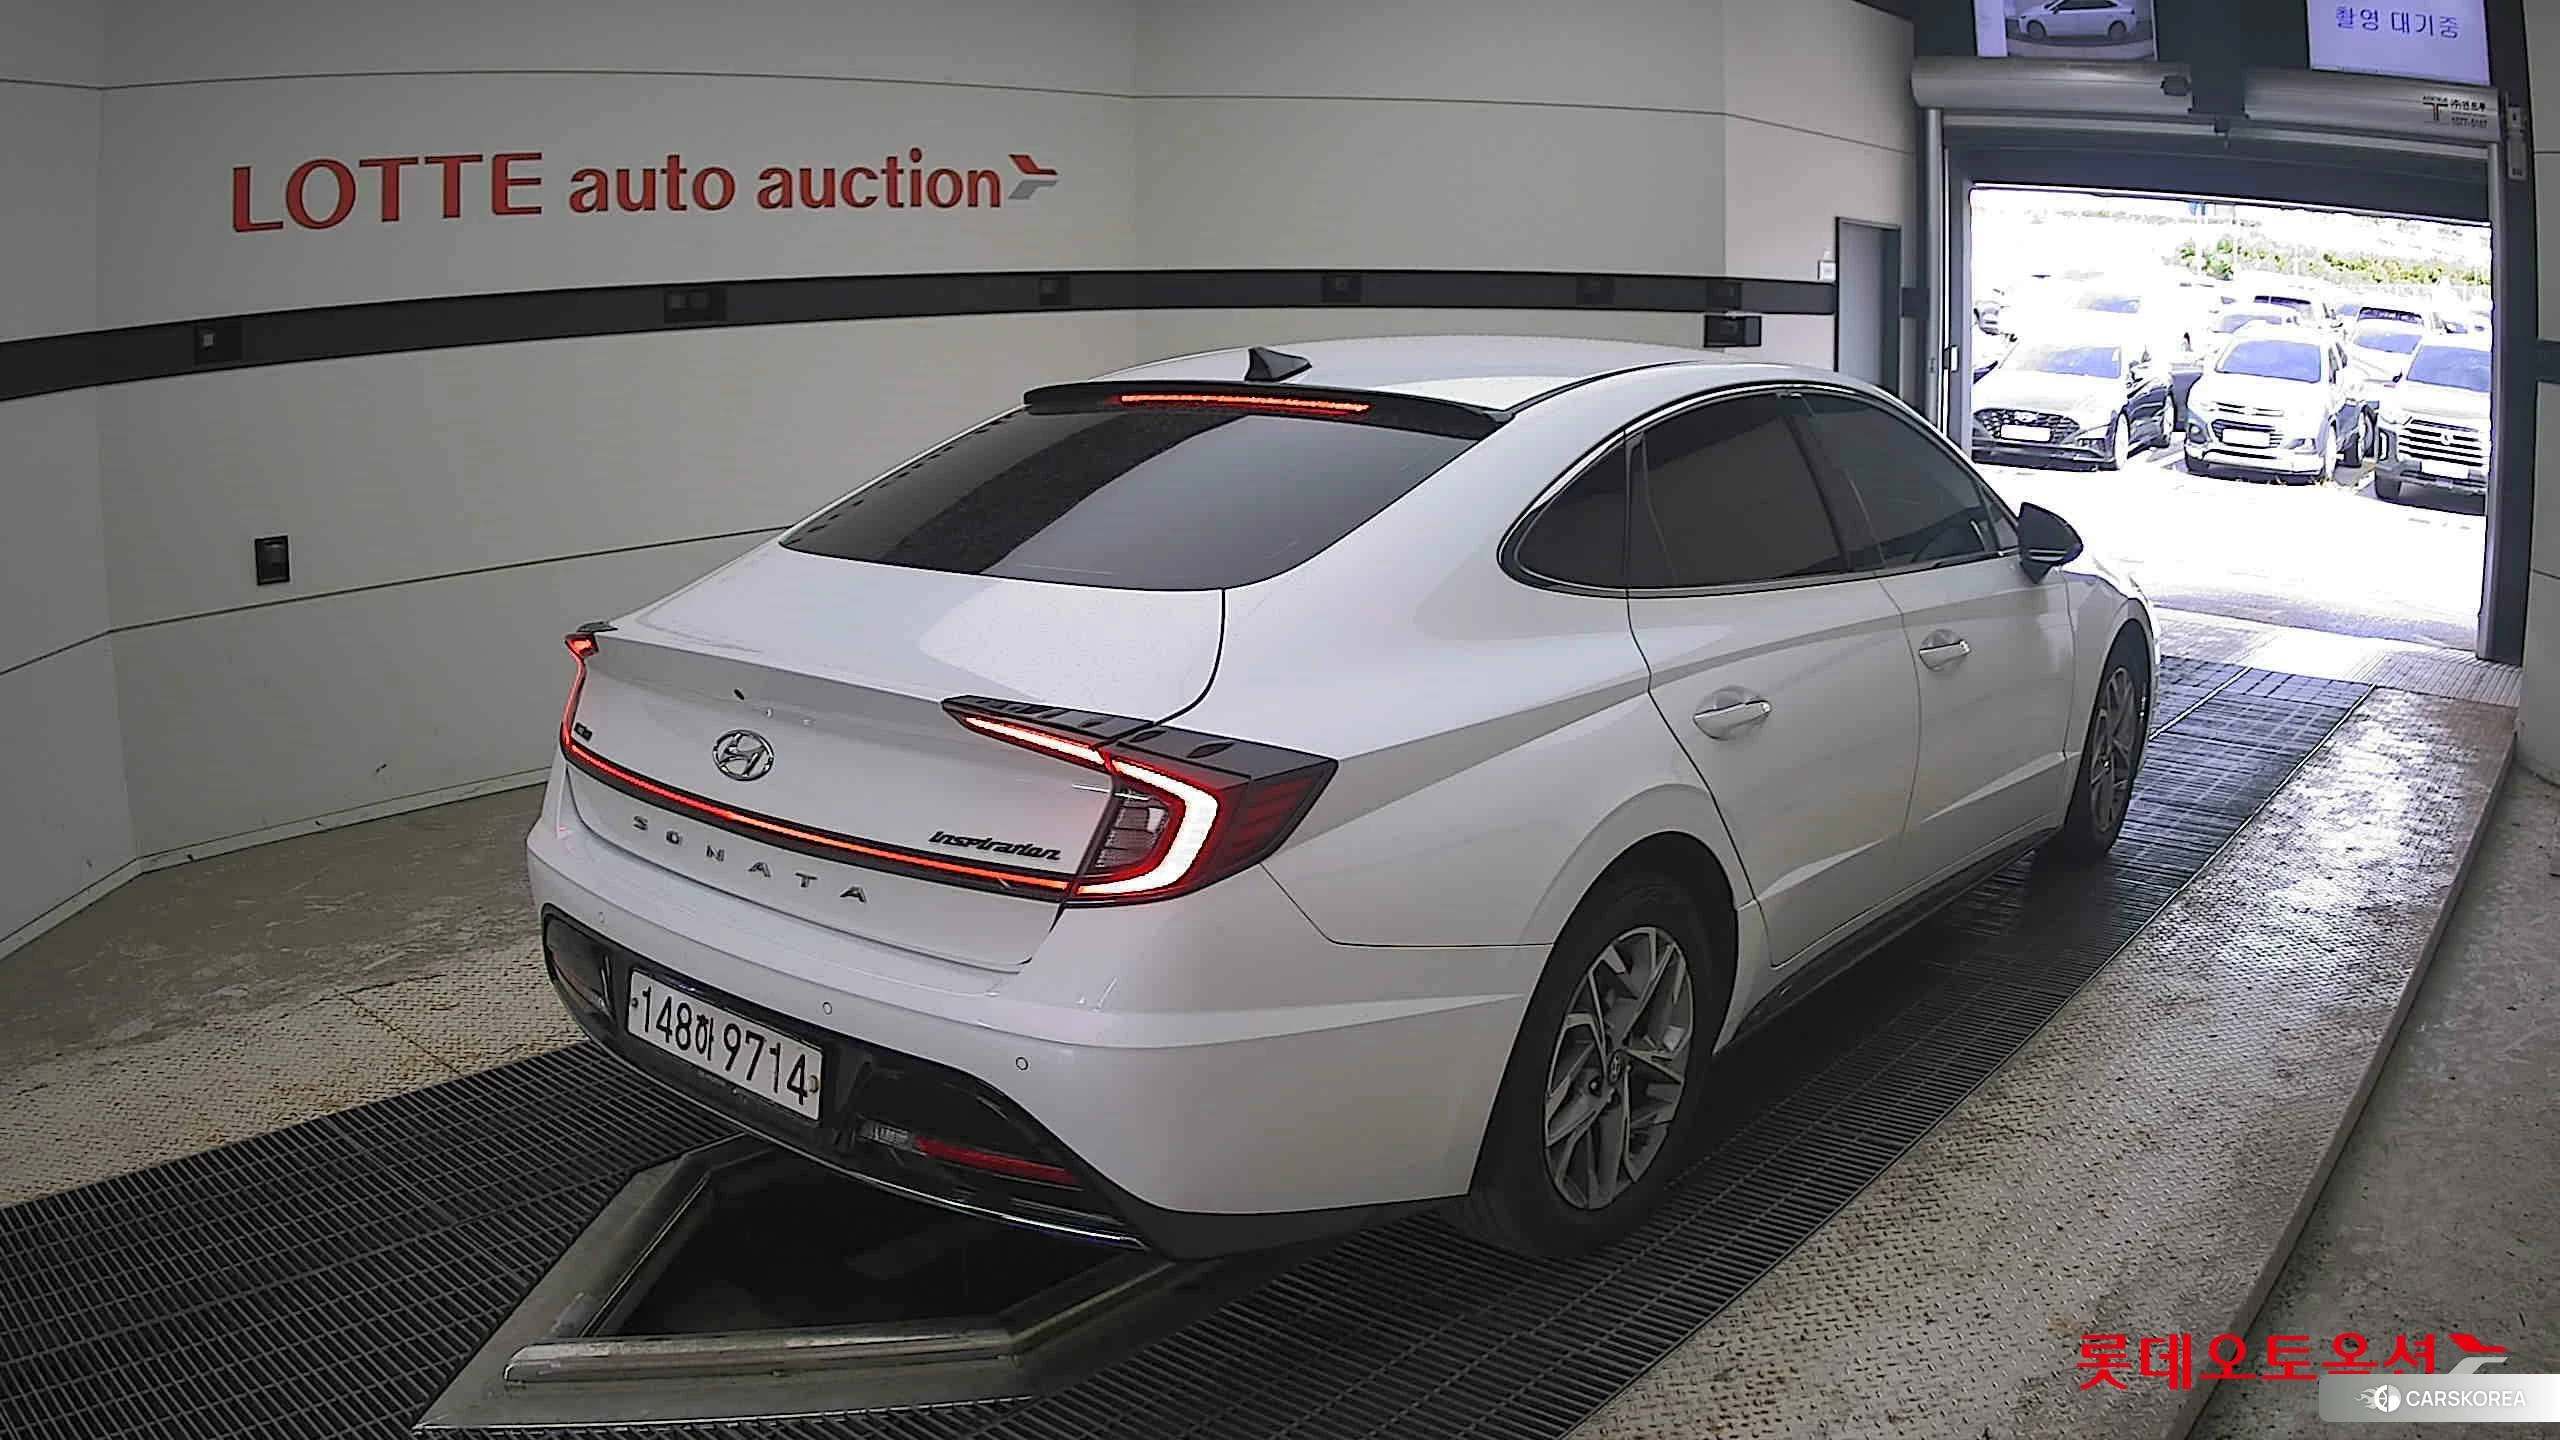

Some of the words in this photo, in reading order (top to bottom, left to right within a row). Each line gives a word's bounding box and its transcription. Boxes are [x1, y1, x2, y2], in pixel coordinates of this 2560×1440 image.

[2391, 11, 2459, 39] 대기중
[232, 152, 543, 233] LOTTE
[569, 153, 737, 214] auto
[756, 147, 1003, 212] auction
[633, 815, 867, 903] SONATA
